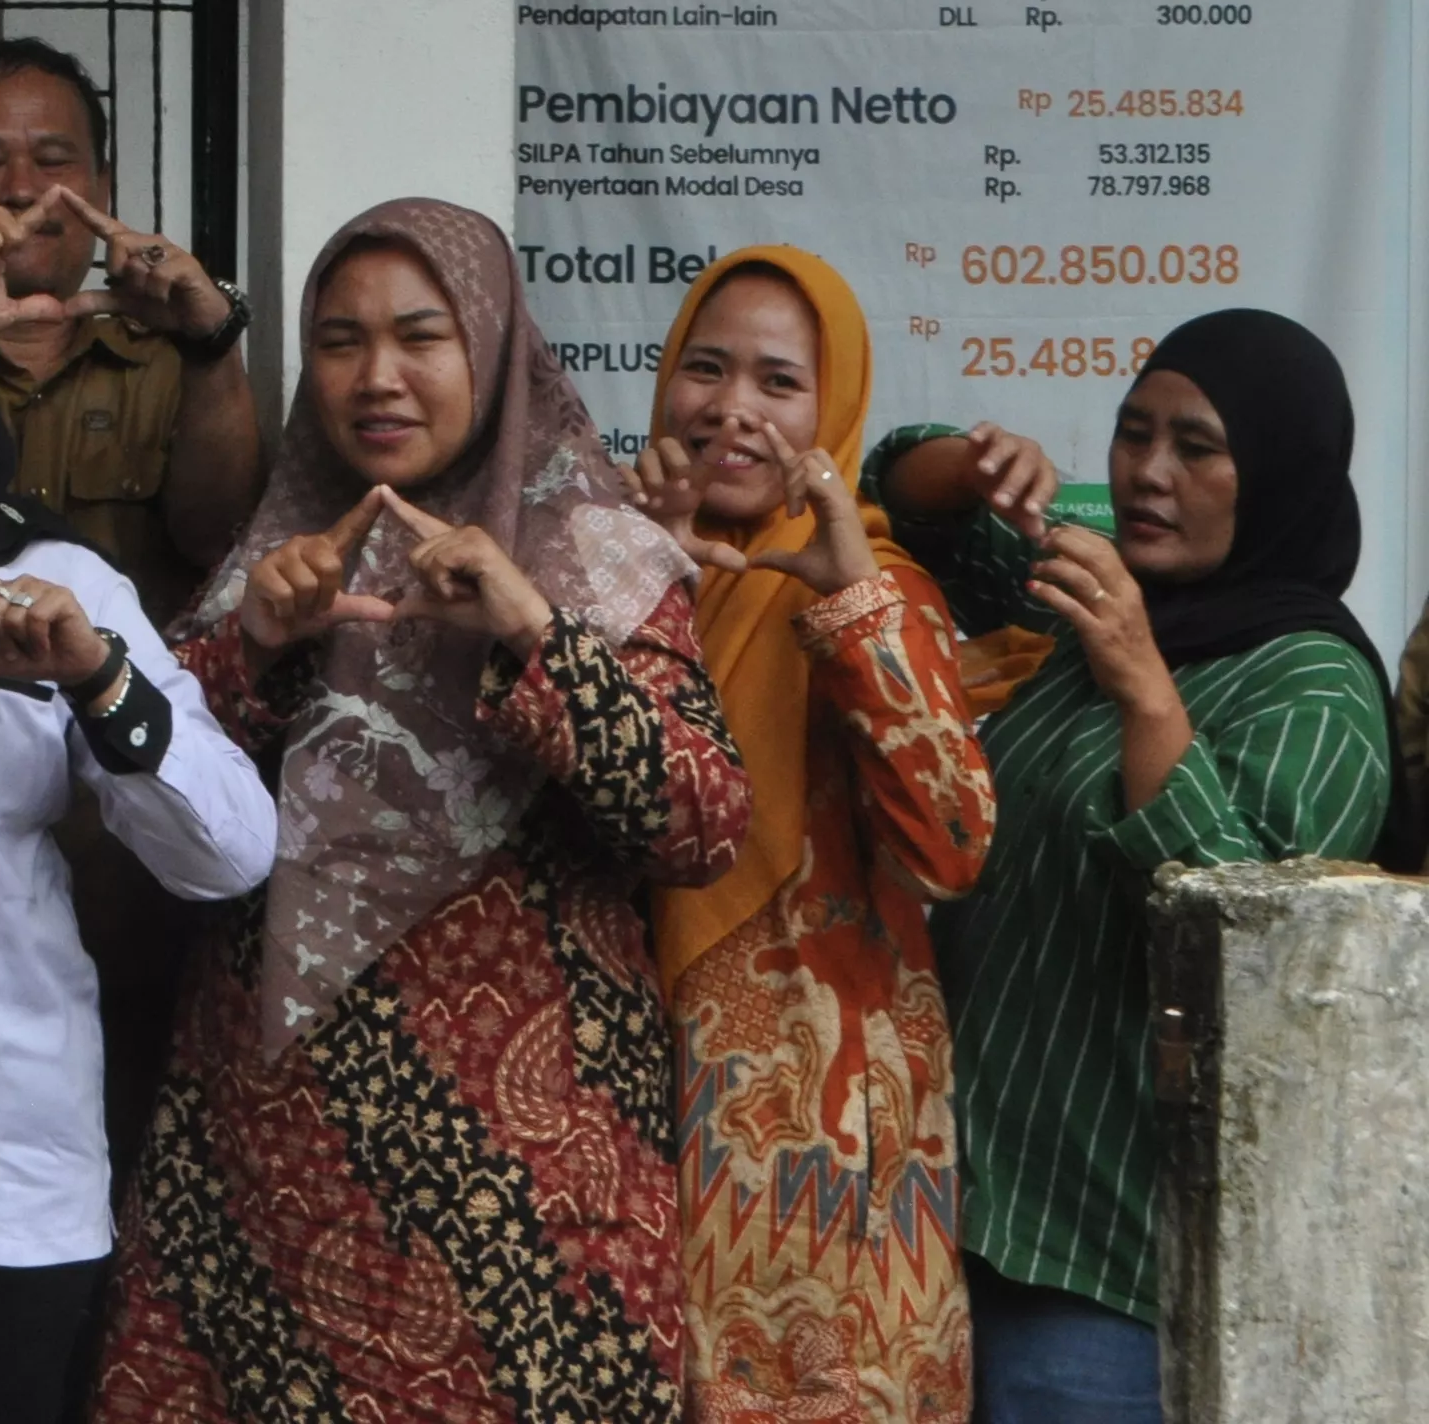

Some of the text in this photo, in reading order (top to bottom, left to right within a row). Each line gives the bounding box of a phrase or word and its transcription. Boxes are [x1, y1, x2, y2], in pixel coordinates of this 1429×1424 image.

[518, 5, 1253, 32] Pendapatan Lain-lain DLL Rp. 300.000
[519, 83, 1245, 137] Pembiayaan Netto Rp 25.485.834
[518, 143, 581, 164] SILPA
[587, 143, 664, 164] Tahun
[669, 143, 820, 170] Sebelumnya
[985, 145, 1021, 171] Rp.
[518, 175, 1211, 203] Penyertaan Modal Desa Rp. 78.797.968
[518, 245, 635, 284] Total
[905, 242, 936, 267] Rp
[961, 245, 1239, 284] 602.850.038
[544, 316, 1156, 377] RPLUS Rp 25.485.8
